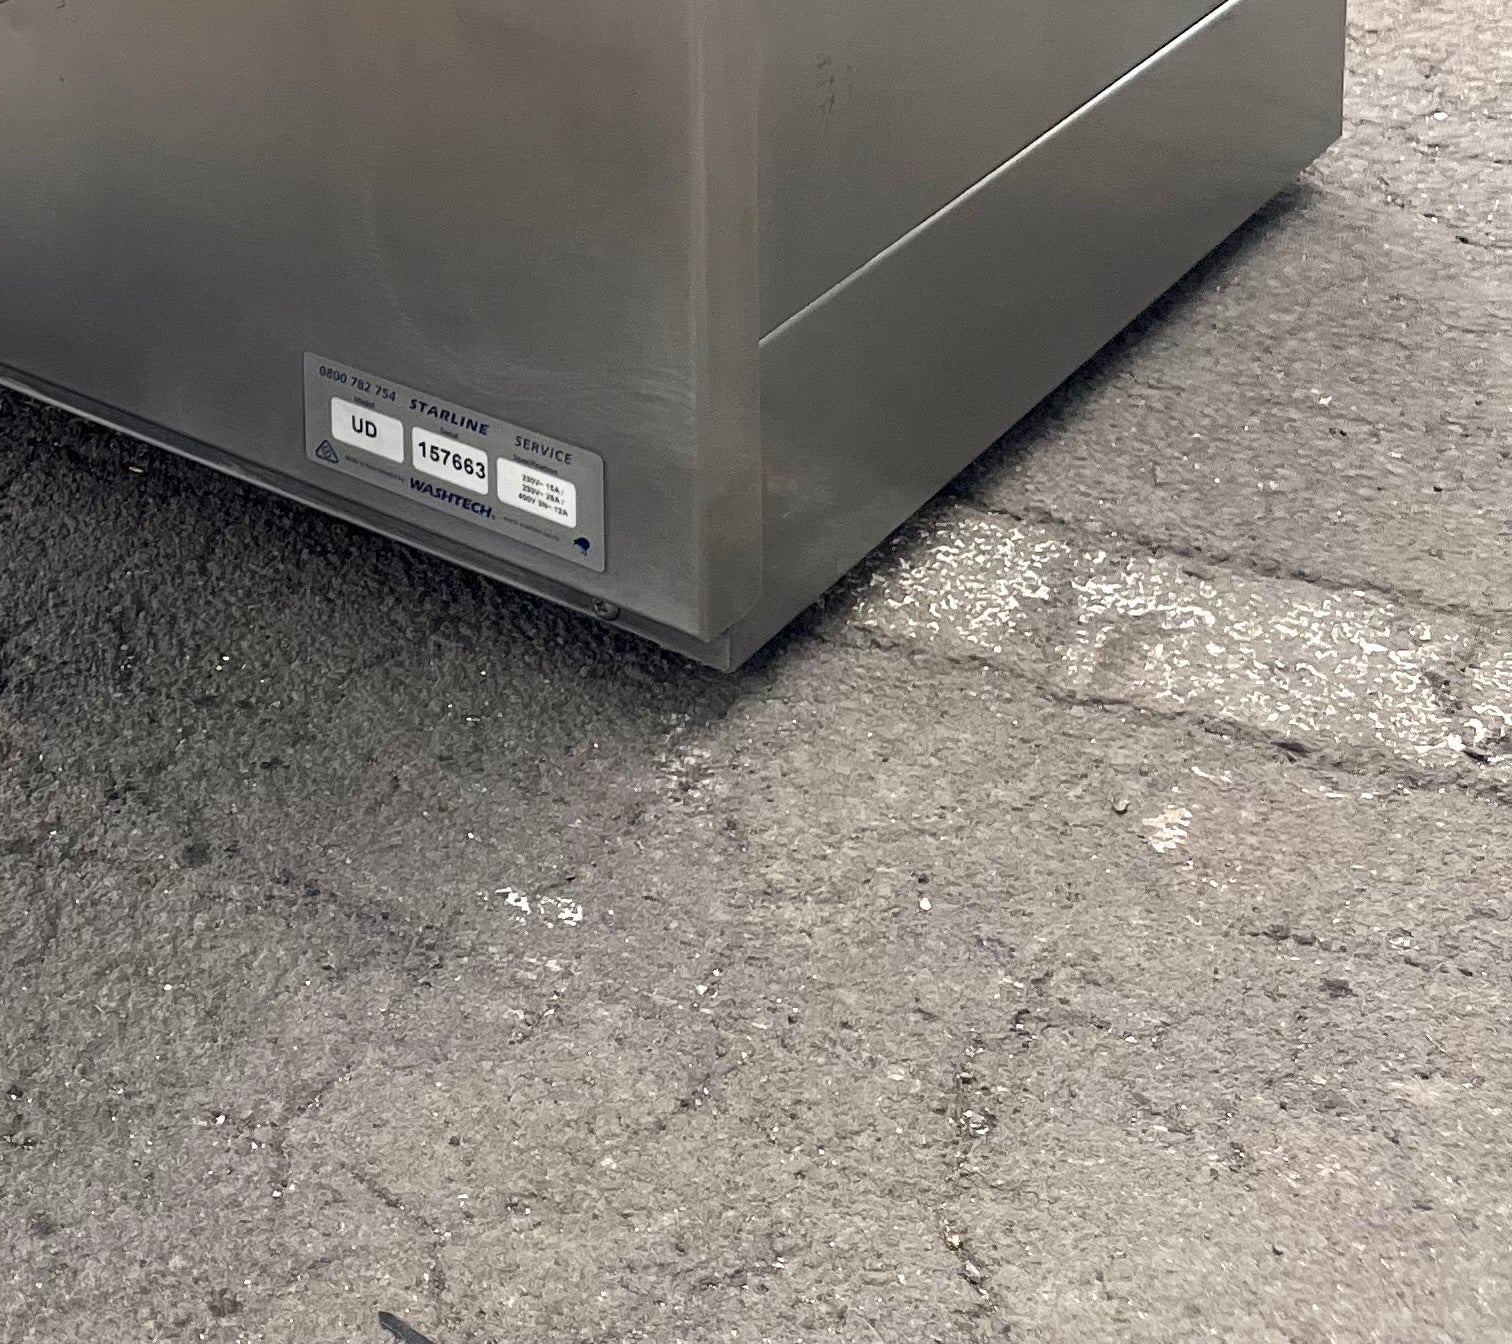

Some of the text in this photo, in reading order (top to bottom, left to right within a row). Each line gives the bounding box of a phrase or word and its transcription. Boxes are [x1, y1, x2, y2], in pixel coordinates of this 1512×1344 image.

[319, 365, 397, 402] 0800 782 754
[351, 415, 378, 438] UD
[409, 399, 490, 436] STARLINE
[417, 441, 486, 480] 157663
[514, 435, 573, 465] SERVICE
[409, 477, 493, 519] WASHTECH
